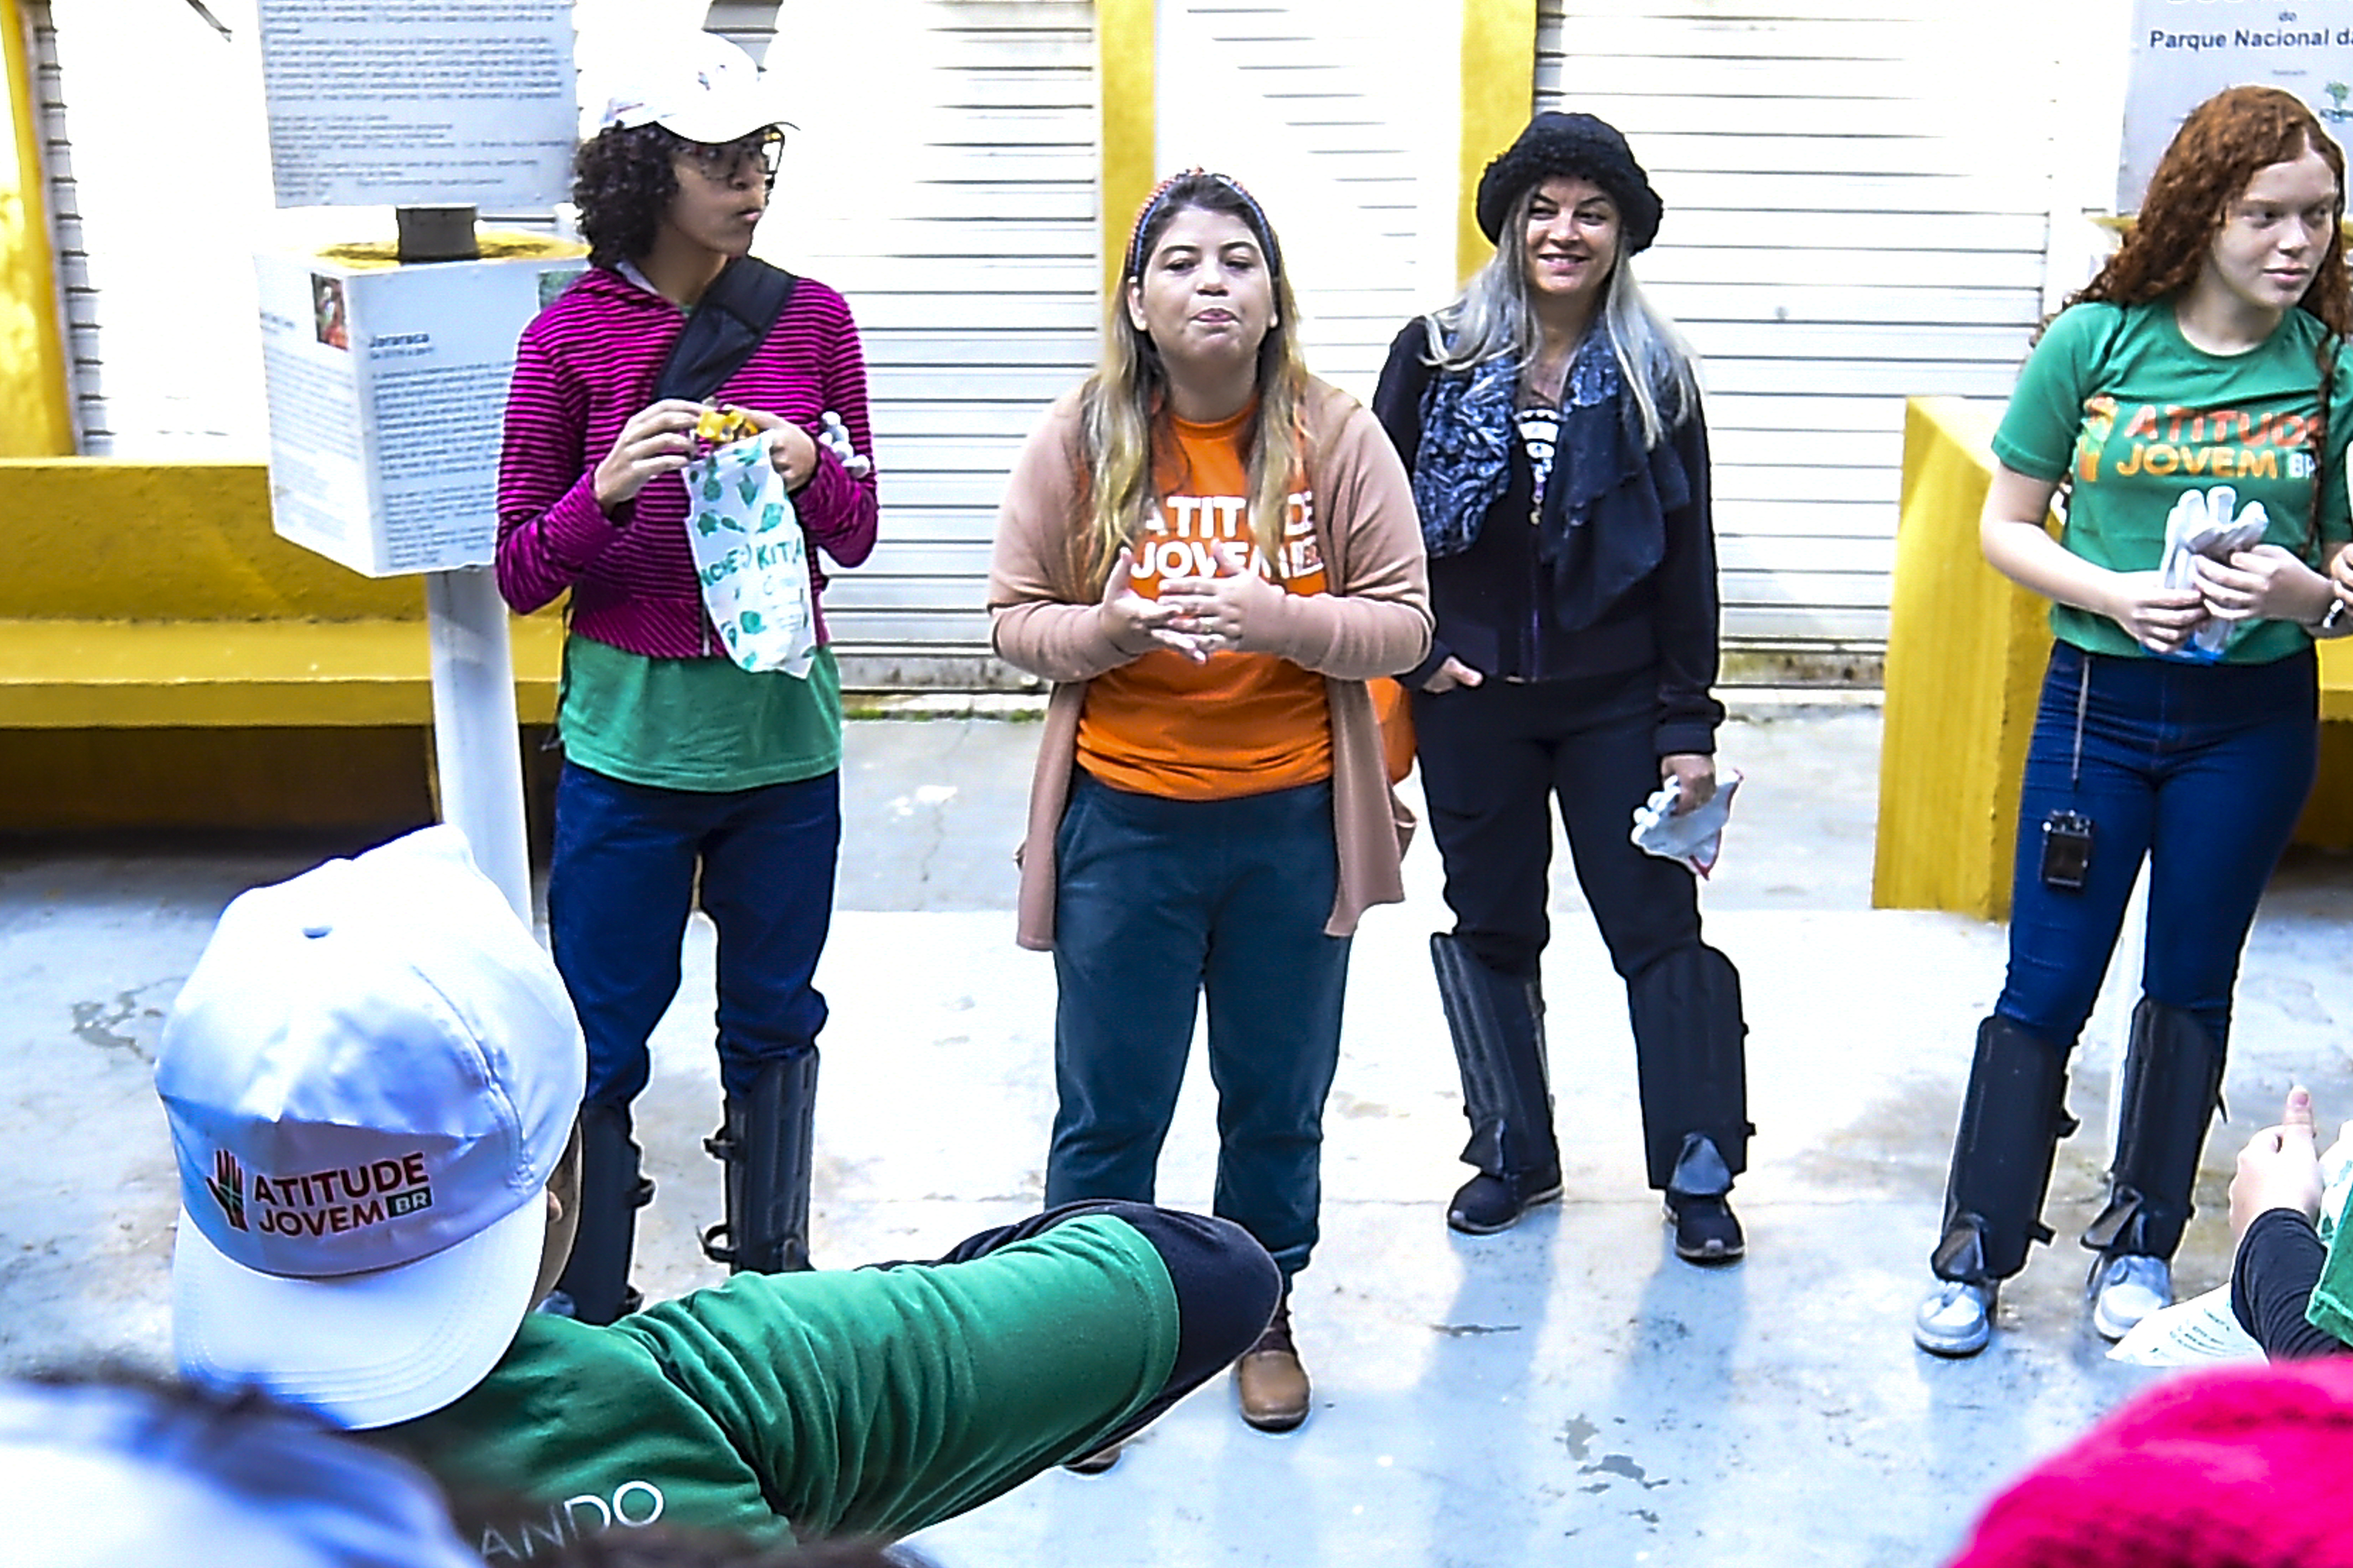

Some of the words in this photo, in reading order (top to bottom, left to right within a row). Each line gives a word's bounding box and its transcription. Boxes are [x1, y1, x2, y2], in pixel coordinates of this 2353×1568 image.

[2278, 11, 2298, 22] do
[2150, 30, 2227, 52] Parque
[2235, 27, 2329, 47] Nacional
[2337, 27, 2353, 46] d
[2117, 441, 2278, 481] JOVEM
[254, 1151, 430, 1207] ATITUDE
[258, 1199, 385, 1237] JOVEM
[395, 1190, 428, 1214] BR
